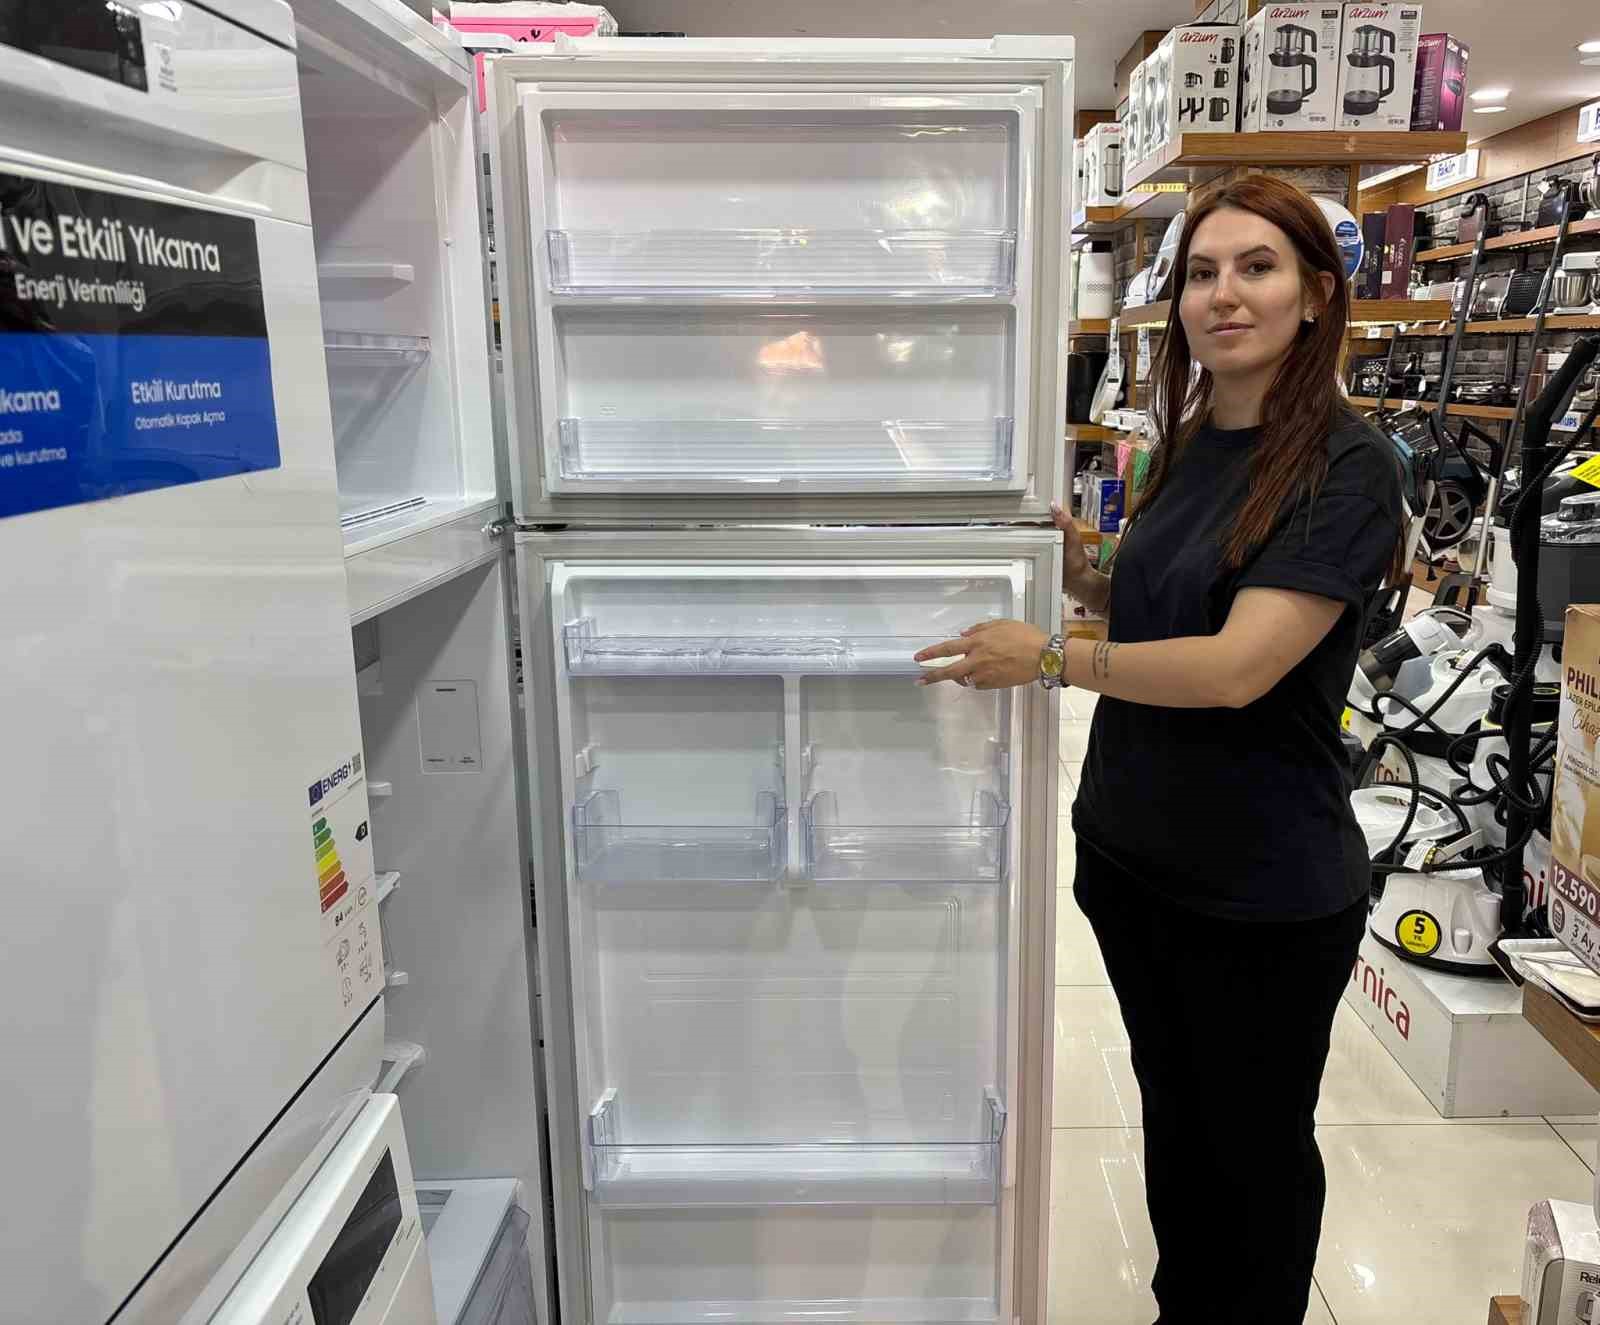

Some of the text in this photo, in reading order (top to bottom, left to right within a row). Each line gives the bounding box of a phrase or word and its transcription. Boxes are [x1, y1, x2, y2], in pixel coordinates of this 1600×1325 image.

[1270, 8, 1309, 19] arzum
[1349, 8, 1388, 19] arzum
[1179, 32, 1218, 44] arzum
[10, 214, 54, 255] ve
[57, 214, 126, 263] Etkili
[128, 225, 220, 272] Yıkama
[14, 274, 67, 309] Enerji
[131, 379, 222, 404] Etkili Kurutma
[134, 410, 225, 430] Otomatik Kapak Açma
[15, 447, 67, 466] kurutma
[1567, 666, 1600, 700] PHIL
[1554, 865, 1596, 916] 12.590
[1413, 917, 1425, 935] 5
[1572, 924, 1579, 938] 3
[1581, 932, 1594, 953] Ay
